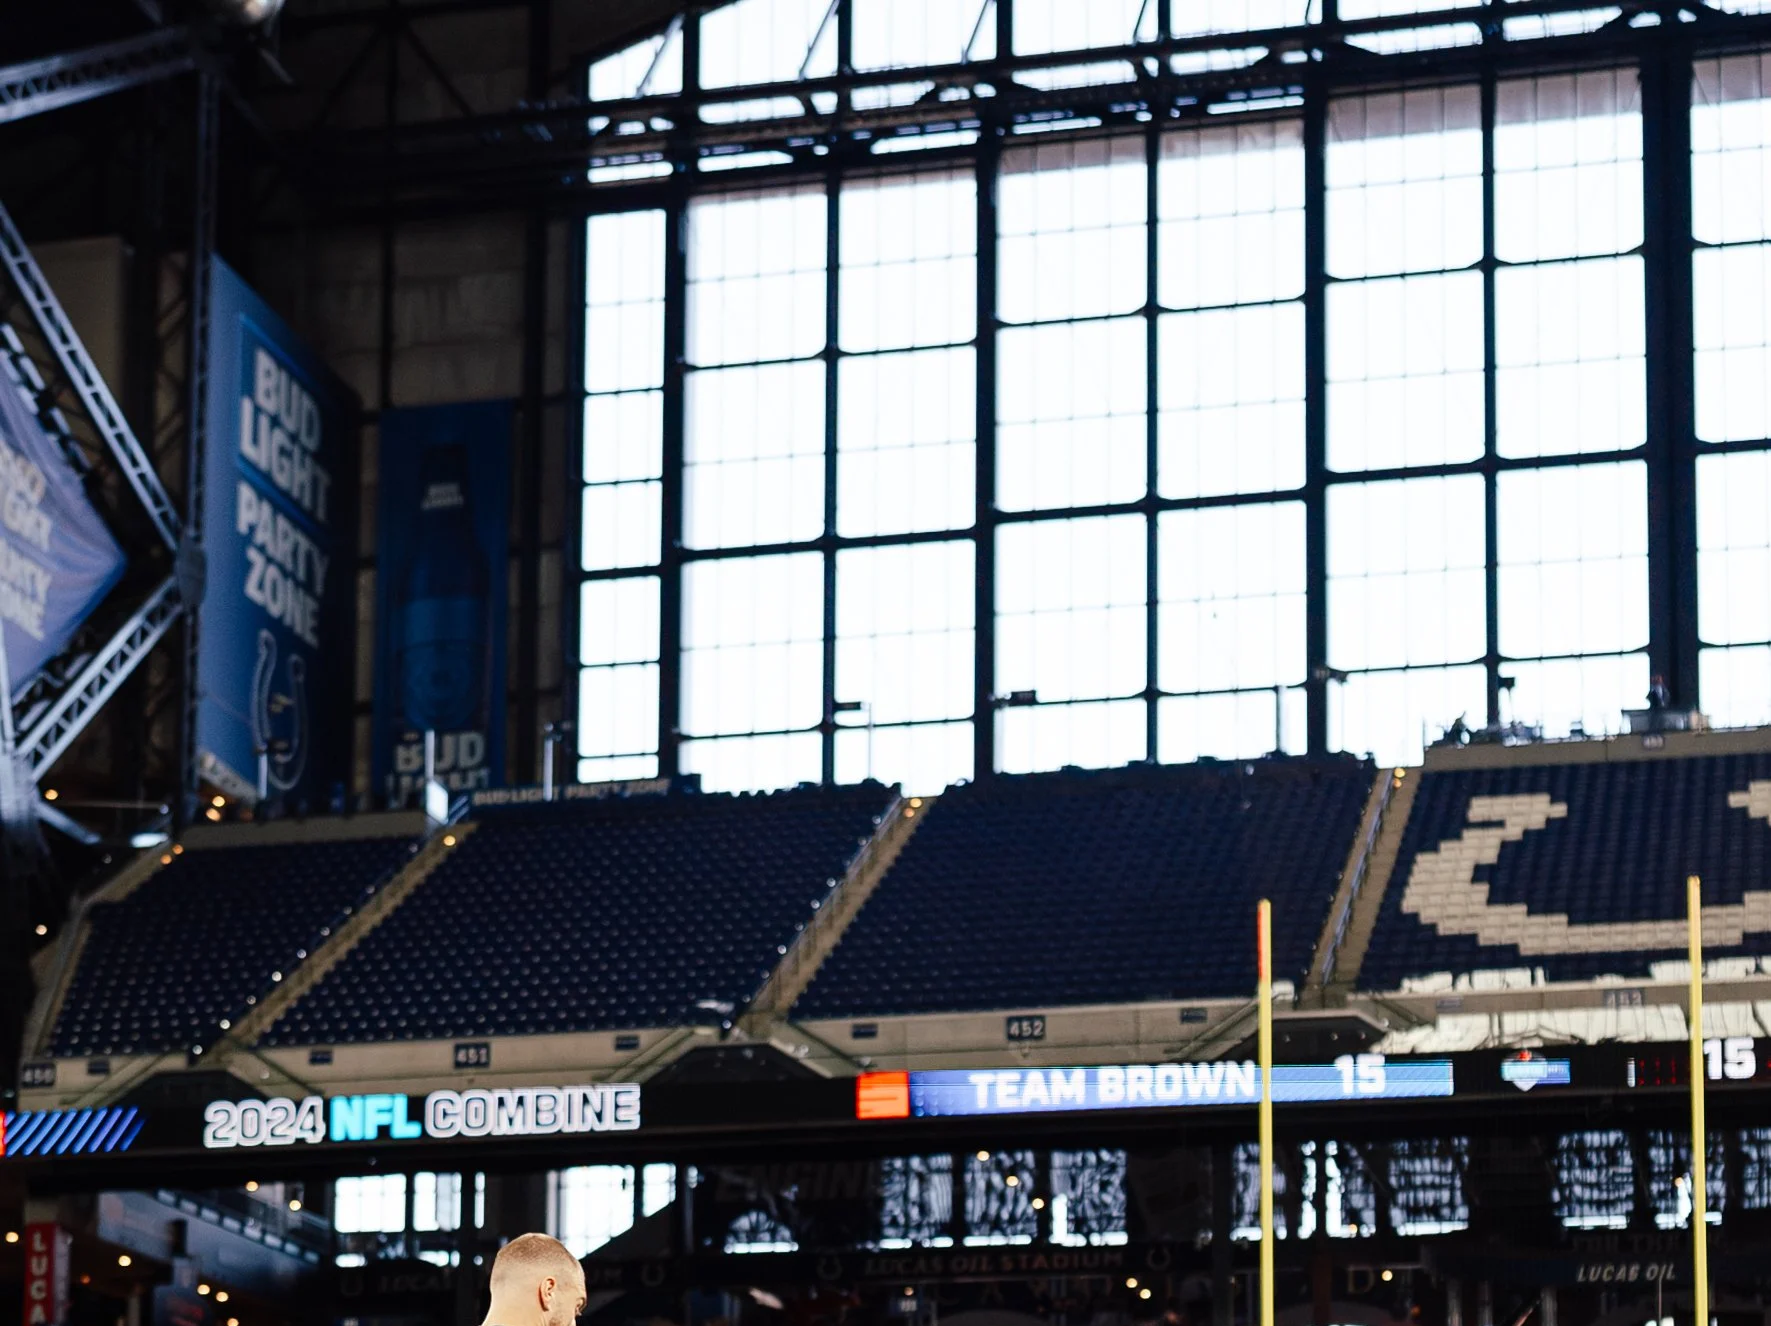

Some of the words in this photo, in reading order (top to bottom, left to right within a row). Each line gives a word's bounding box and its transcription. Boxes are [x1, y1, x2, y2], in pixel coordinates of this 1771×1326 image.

[253, 348, 322, 454] BUD
[240, 395, 332, 522] LIGHT
[236, 481, 331, 598] PARTY
[245, 544, 319, 649] ZONE
[394, 731, 486, 773] BUD
[1010, 1020, 1043, 1037] 452
[1702, 1037, 1757, 1079] 15
[969, 1070, 1086, 1108] TEAM
[1098, 1061, 1255, 1101] BROWN
[1334, 1054, 1385, 1095] 15
[204, 1097, 326, 1148] 2024
[330, 1094, 421, 1141] NFL
[425, 1083, 641, 1138] COMBINE
[1576, 1262, 1640, 1282] LUCAS
[1645, 1261, 1676, 1281] OIL
